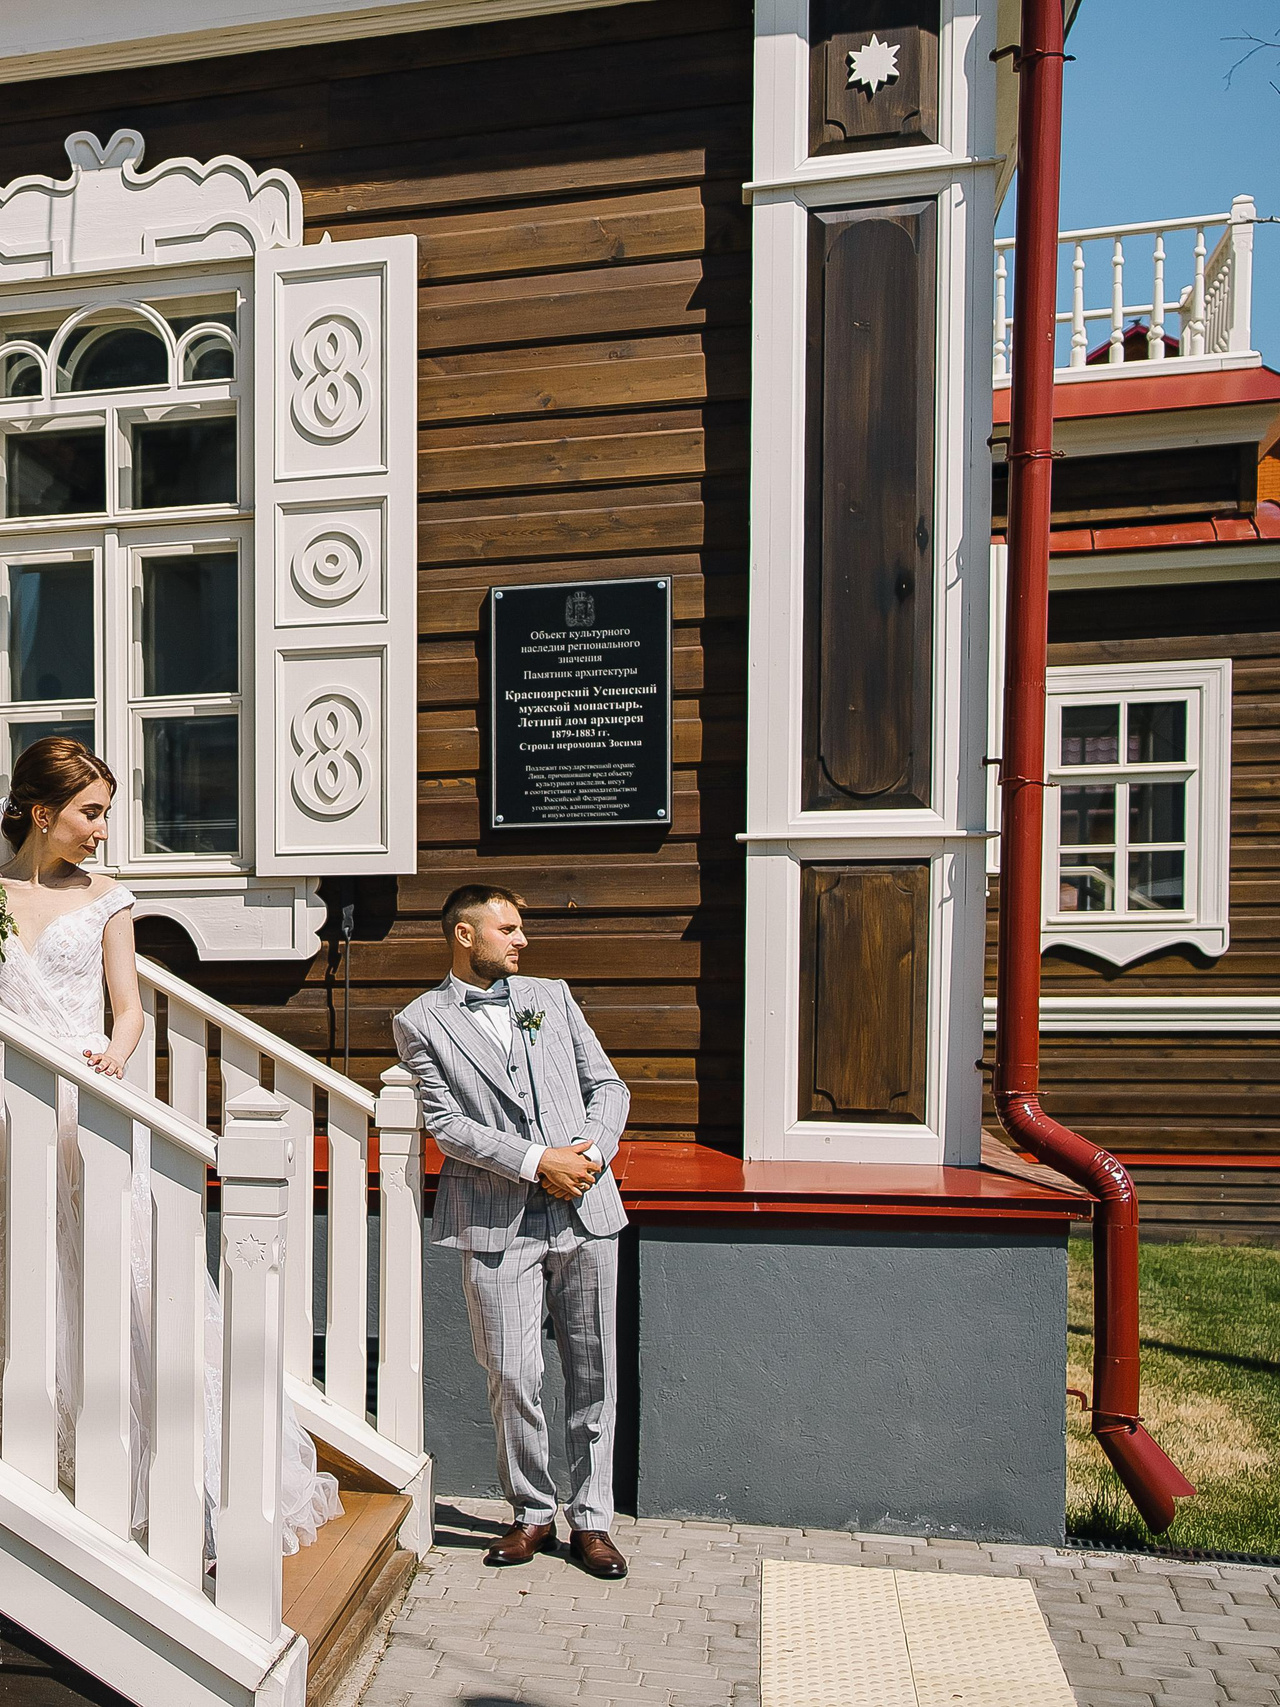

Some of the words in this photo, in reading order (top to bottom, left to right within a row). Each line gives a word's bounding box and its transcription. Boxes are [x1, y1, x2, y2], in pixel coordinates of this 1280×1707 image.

[530, 630, 567, 640] Объект
[569, 628, 630, 640] культурного
[521, 644, 565, 653] наследия
[568, 641, 640, 653] регионального
[558, 655, 602, 663] значения
[524, 670, 572, 680] Памятник
[575, 667, 638, 678] архитектуры
[505, 687, 589, 702] Красноярский
[593, 684, 657, 696] Успенский
[519, 702, 570, 715] мужской
[574, 701, 643, 712] монастырь.
[517, 717, 562, 728] Летний
[565, 717, 587, 726] дом
[590, 714, 644, 727] архиерея
[551, 729, 596, 738] 1879-1883
[597, 729, 610, 737] гг.
[519, 742, 554, 752] Строил
[556, 741, 606, 751] иеромонах
[609, 739, 642, 747] Зосима
[558, 763, 611, 771] государственной
[544, 795, 581, 803] Российской
